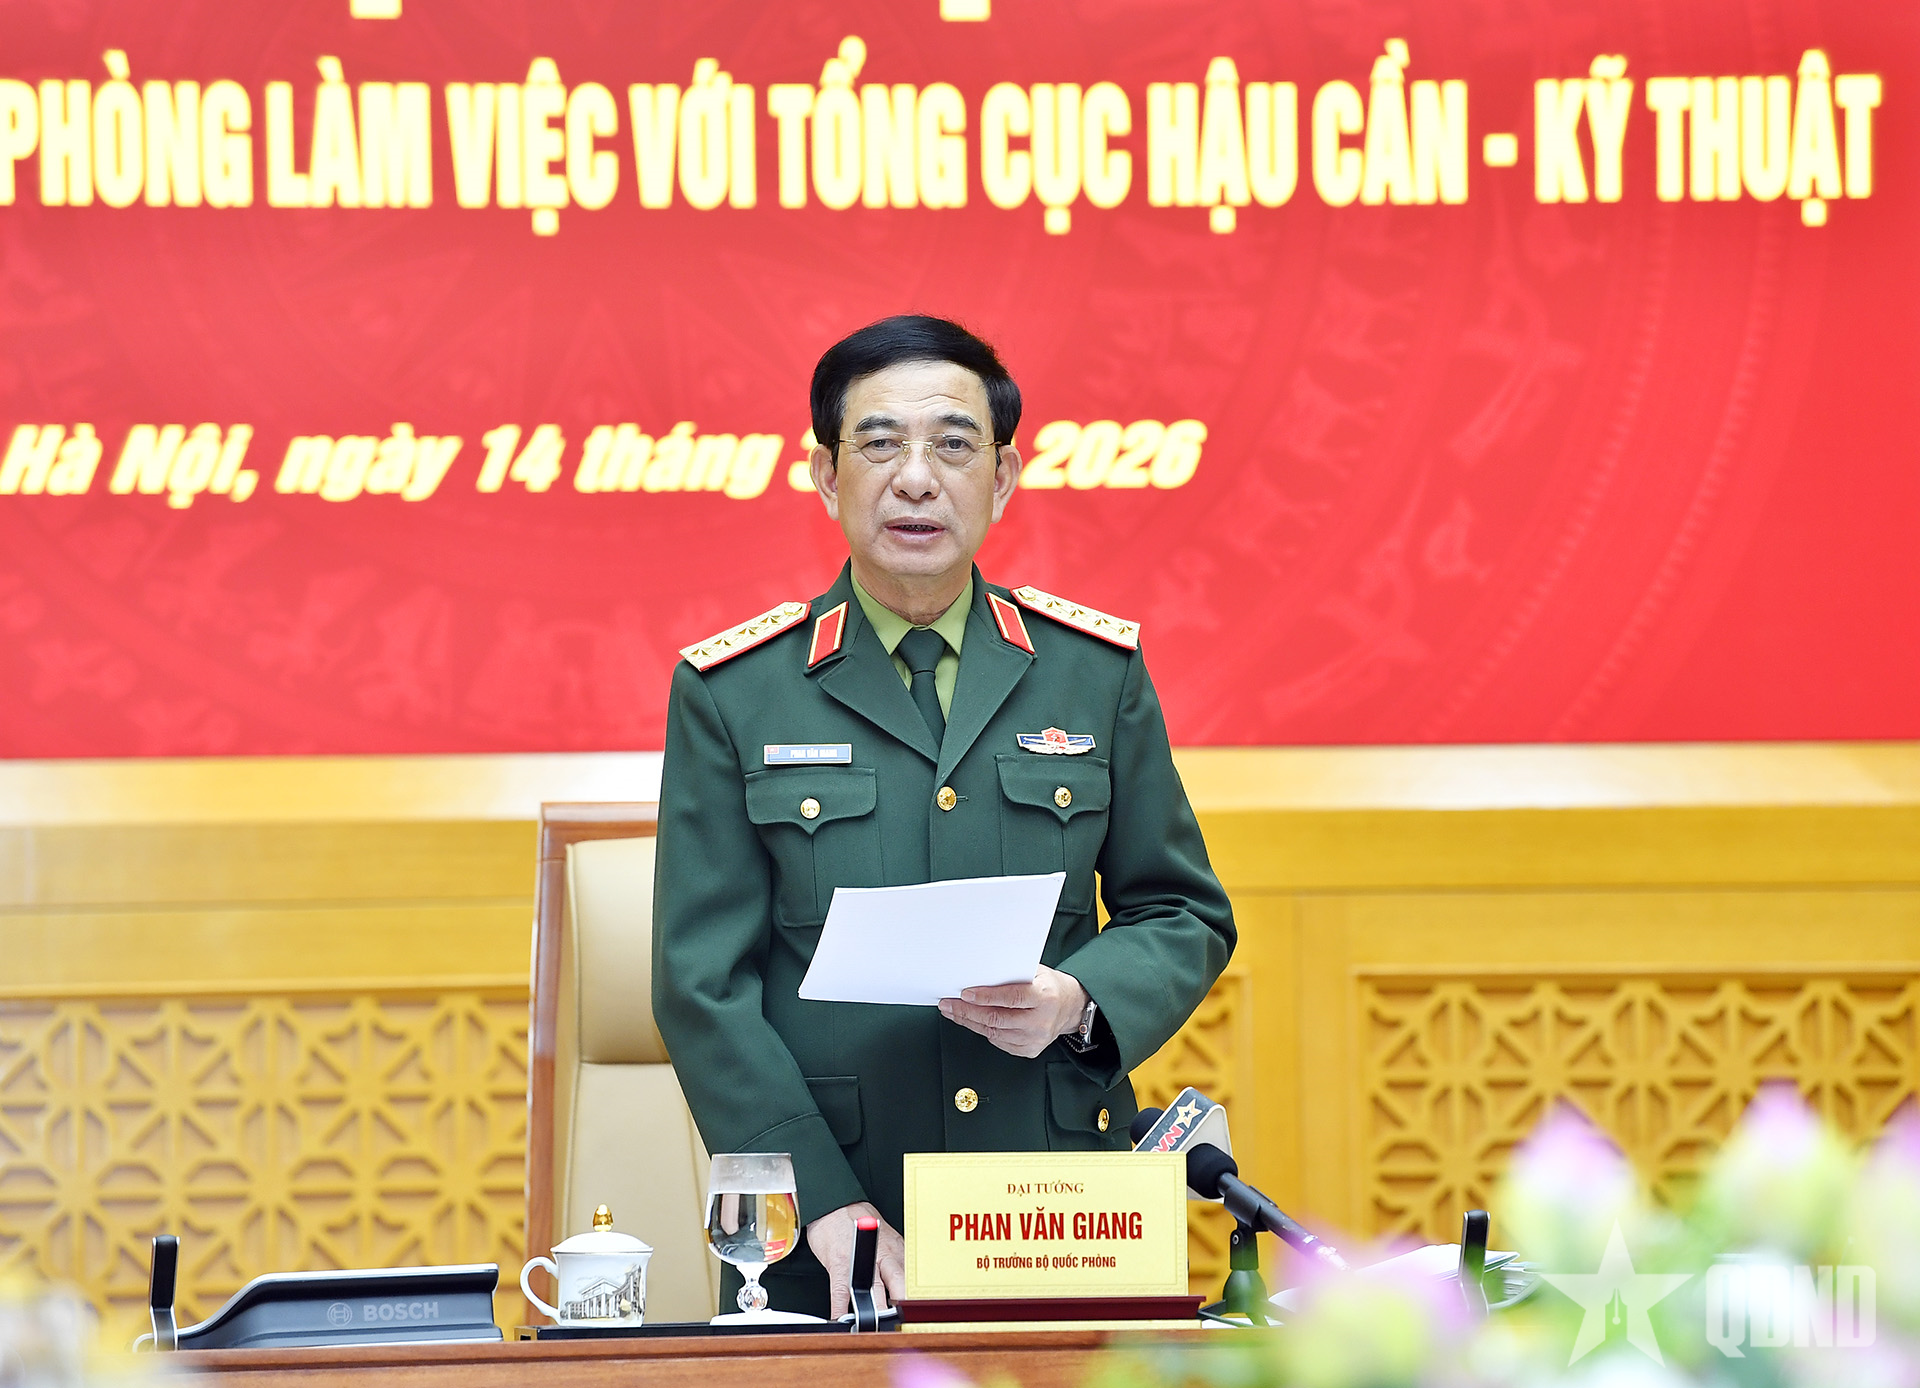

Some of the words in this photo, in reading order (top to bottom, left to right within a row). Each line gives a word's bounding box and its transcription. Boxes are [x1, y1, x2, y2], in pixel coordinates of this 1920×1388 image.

[0, 49, 254, 209] PHÒNG
[265, 55, 433, 209] LÀM
[444, 56, 620, 236] VIỆC
[627, 57, 757, 210] VỚI
[767, 35, 968, 210] TỔNG
[980, 81, 1133, 235] CỤC
[1146, 56, 1299, 234] HẬU
[1311, 38, 1469, 207] CẦN
[1534, 54, 1634, 204] KỸ
[1645, 49, 1882, 227] THUẬT
[0, 422, 103, 496] Hà
[109, 422, 259, 510] Nội,
[274, 422, 463, 503] ngày
[476, 423, 566, 493] 14
[573, 421, 785, 500] tháng
[1019, 420, 1208, 490] 2026
[1006, 1182, 1031, 1198] ĐẠI
[1033, 1179, 1085, 1195] TƯỚNG
[949, 1212, 1012, 1242] PHAN
[1018, 1206, 1065, 1241] VĂN
[1072, 1211, 1143, 1241] GIANG
[976, 1254, 990, 1272] BỘ
[992, 1252, 1033, 1269] TRƯỞNG
[1035, 1254, 1050, 1271] BỘ
[1052, 1252, 1080, 1270] QUỐC
[1081, 1253, 1117, 1268] PHÒNG
[362, 1301, 440, 1322] BOSCH
